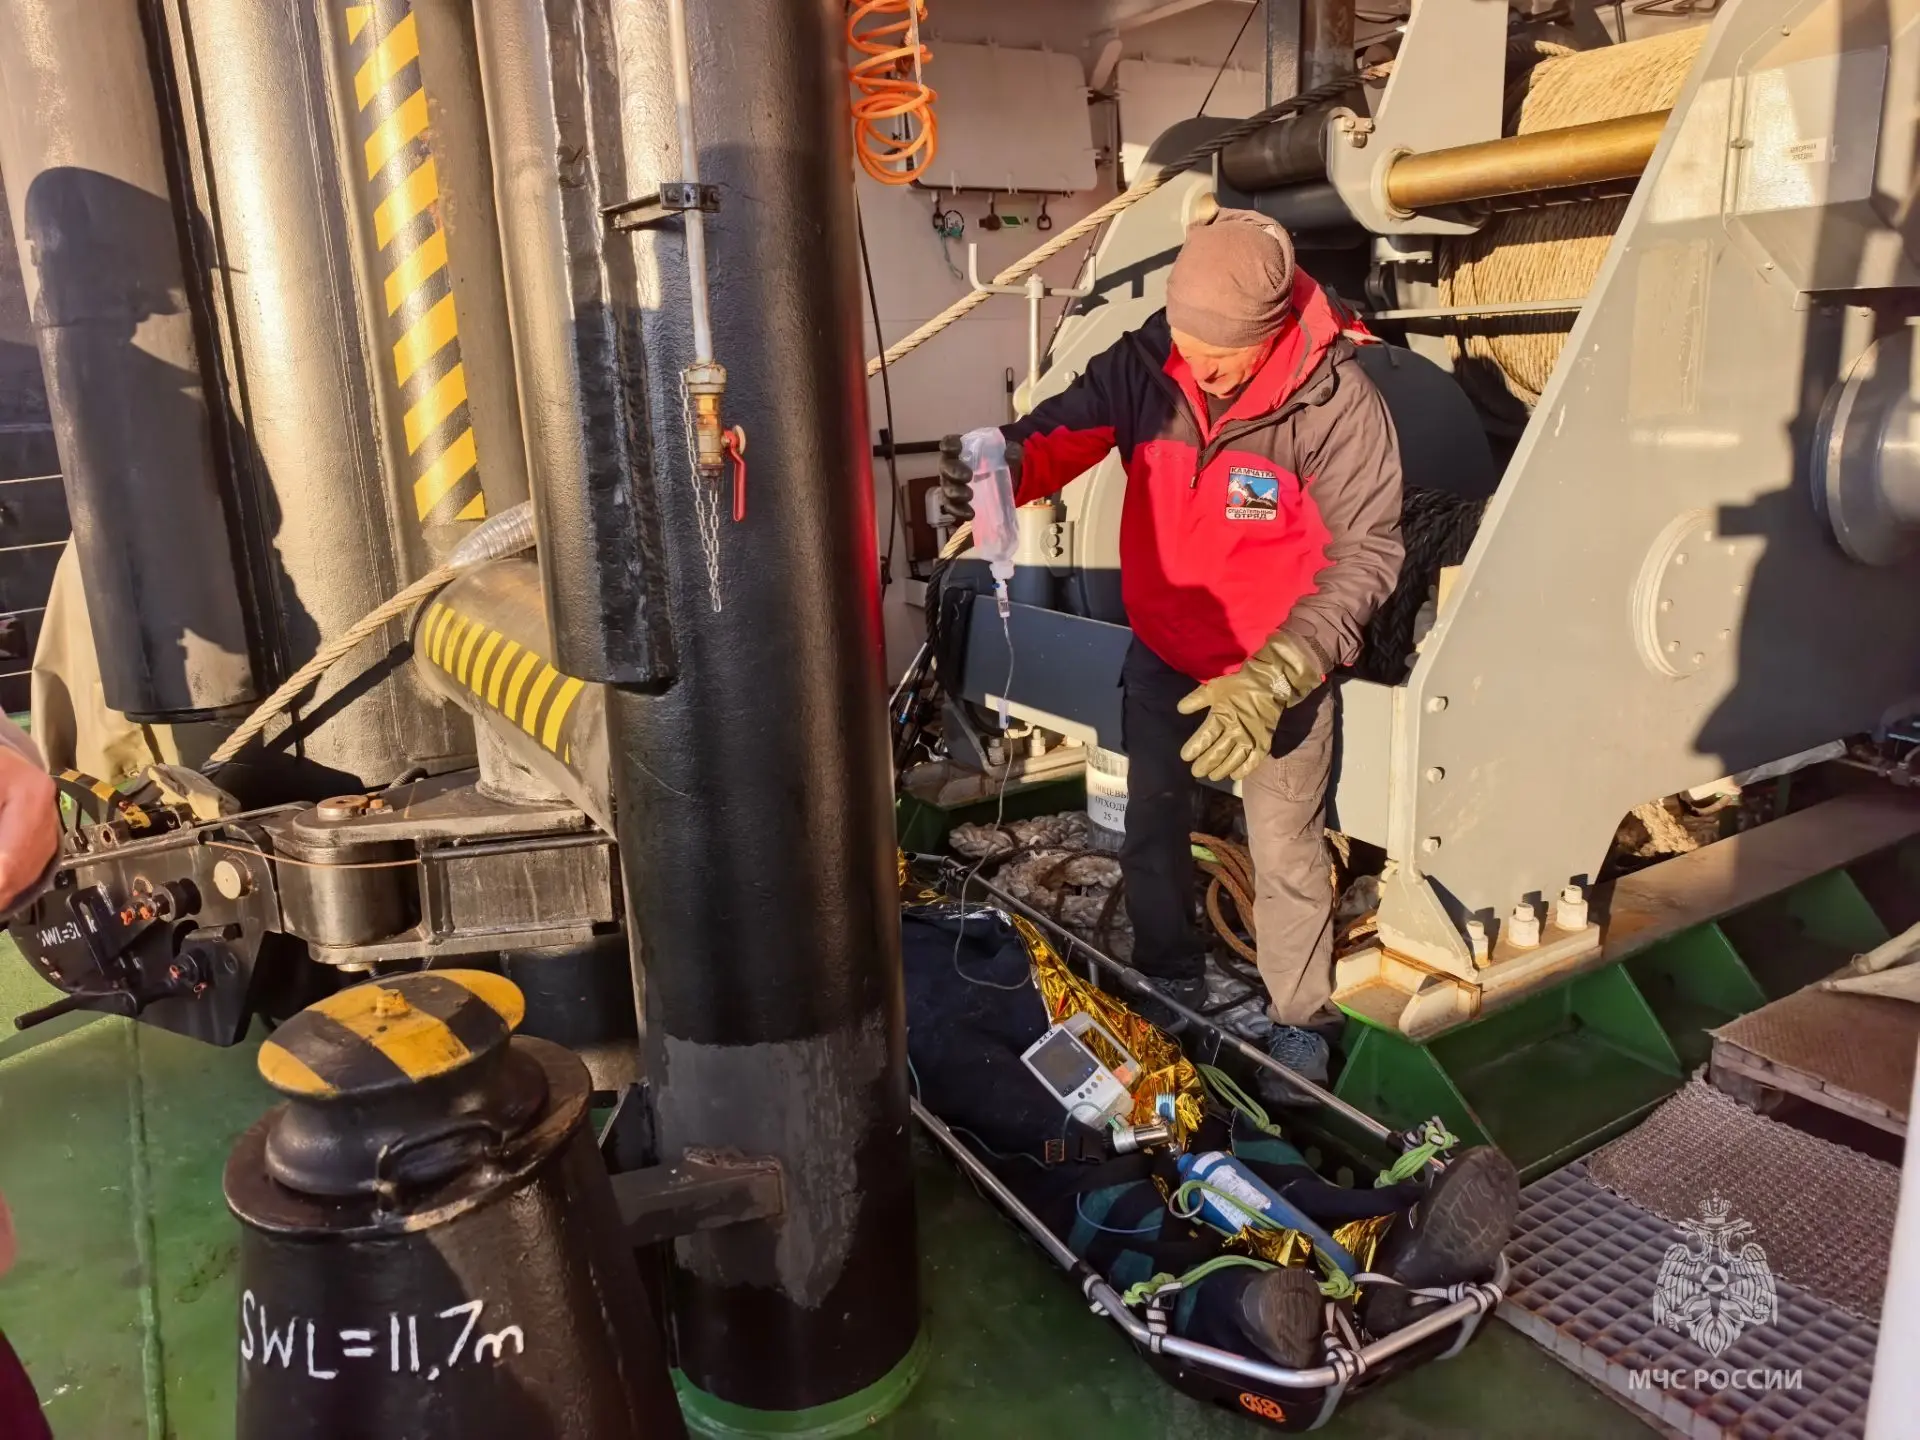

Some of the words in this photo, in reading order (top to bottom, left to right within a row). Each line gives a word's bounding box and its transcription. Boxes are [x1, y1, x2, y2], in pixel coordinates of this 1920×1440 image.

[1230, 467, 1276, 478] КАМЧАТКА
[1095, 783, 1129, 800] ПИЩЕВЫ
[1103, 812, 1112, 821] 25
